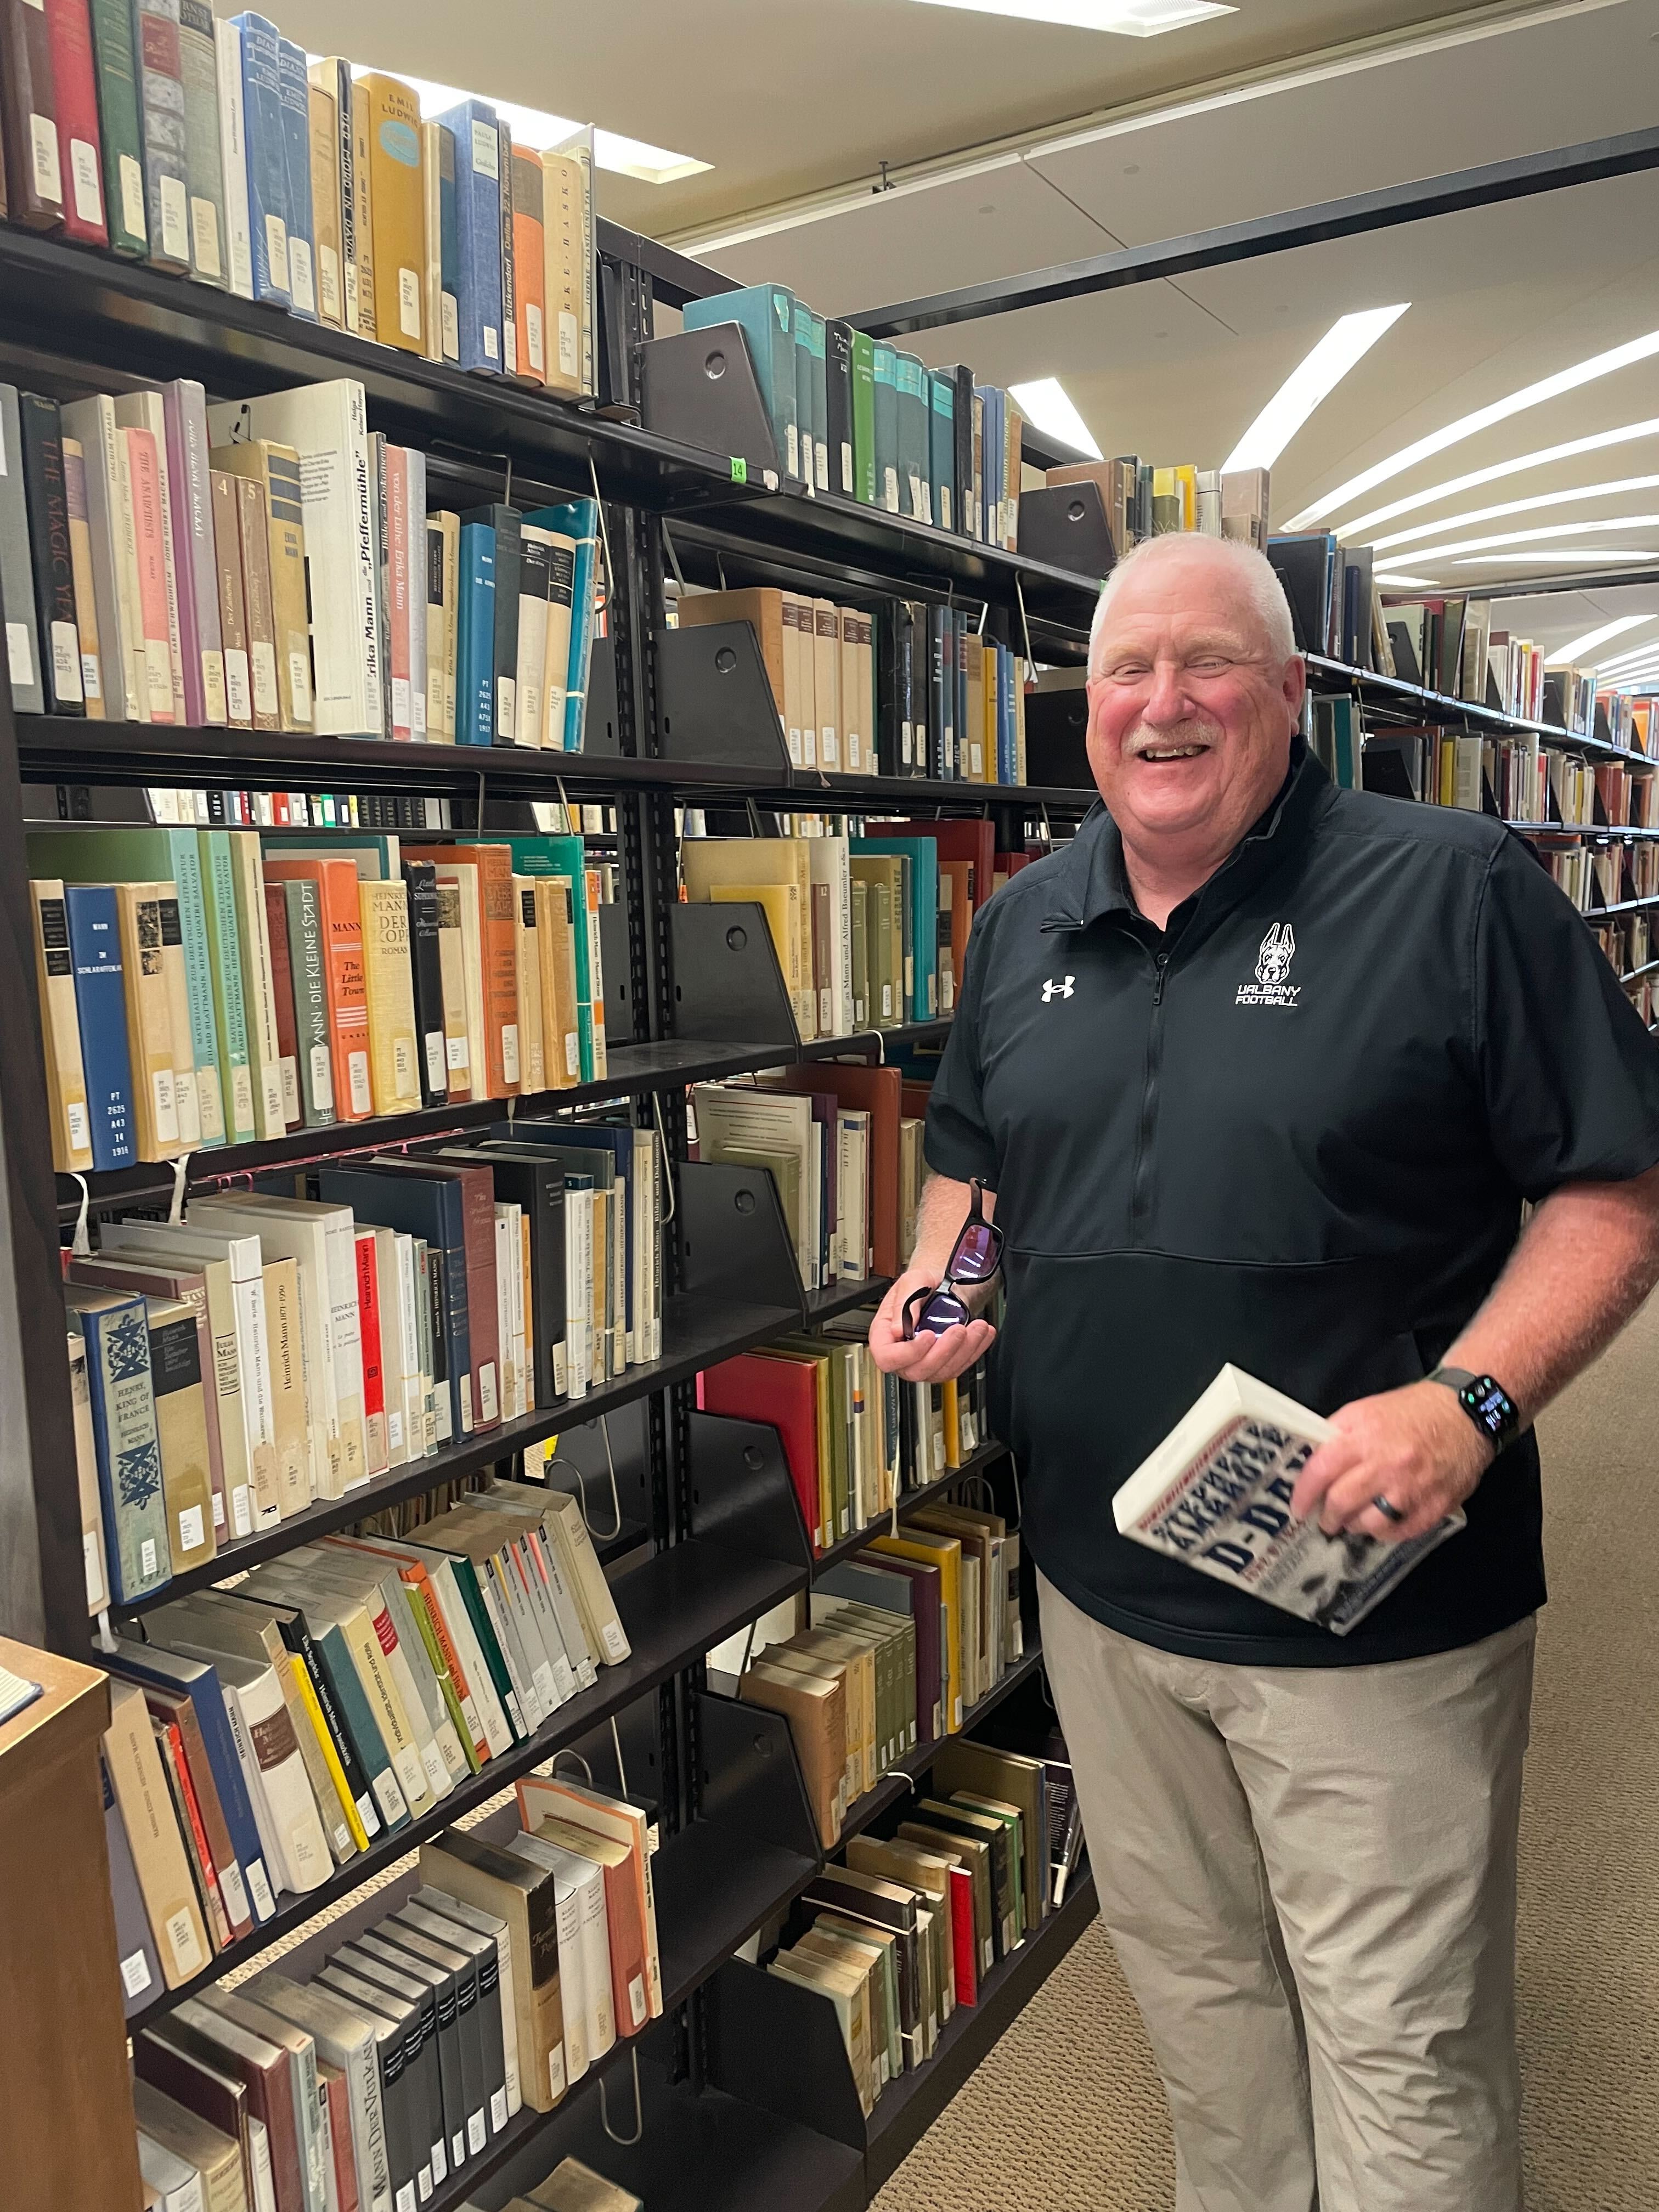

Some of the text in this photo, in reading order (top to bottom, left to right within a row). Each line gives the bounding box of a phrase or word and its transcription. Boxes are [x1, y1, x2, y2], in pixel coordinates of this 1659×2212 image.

[388, 94, 414, 112] EMIL
[503, 140, 511, 192] November
[504, 212, 513, 250] Dallas
[379, 441, 387, 501] Dokumente
[732, 464, 745, 478] 14
[138, 451, 154, 539] THE ANARCHISTS
[218, 479, 228, 496] 4
[247, 483, 256, 500] 5
[393, 495, 403, 513] der
[48, 495, 71, 578] MAGIC
[394, 549, 404, 579] Erika
[55, 583, 73, 623] YEA
[396, 580, 405, 611] Mann
[364, 596, 375, 641] Mann
[482, 680, 489, 688] PT
[179, 853, 189, 904] LITERATUR
[189, 854, 199, 899] SALVATOR
[194, 902, 204, 939] QUATRE
[332, 922, 362, 933] MANN
[379, 916, 407, 930] DER
[185, 912, 196, 963] DEUTSCHEN
[301, 883, 322, 1004] DIE KLEINE STADT
[343, 961, 360, 971] The
[1235, 995, 1299, 1007] FOOTBALL
[1237, 984, 1301, 997] UALBANY
[192, 985, 203, 1045] MATERIALIEN
[107, 1105, 126, 1115] 2625
[110, 1092, 120, 1101] PT
[110, 1119, 126, 1128] A43
[364, 1272, 372, 1310] Heinrich
[335, 1311, 356, 1323] MANN
[280, 1322, 290, 1350] Mann
[281, 1350, 292, 1391] Heinrich
[115, 1398, 137, 1412] KING
[117, 1382, 146, 1398] HENRY,
[118, 1405, 150, 1423] FRANCE
[424, 1593, 443, 1639] HEINRICH
[439, 1635, 453, 1661] MANN
[370, 1658, 379, 1676] und
[228, 1706, 246, 1760] HEINRICH MANN
[368, 2108, 383, 2151] DER
[372, 2149, 387, 2200] MANN
